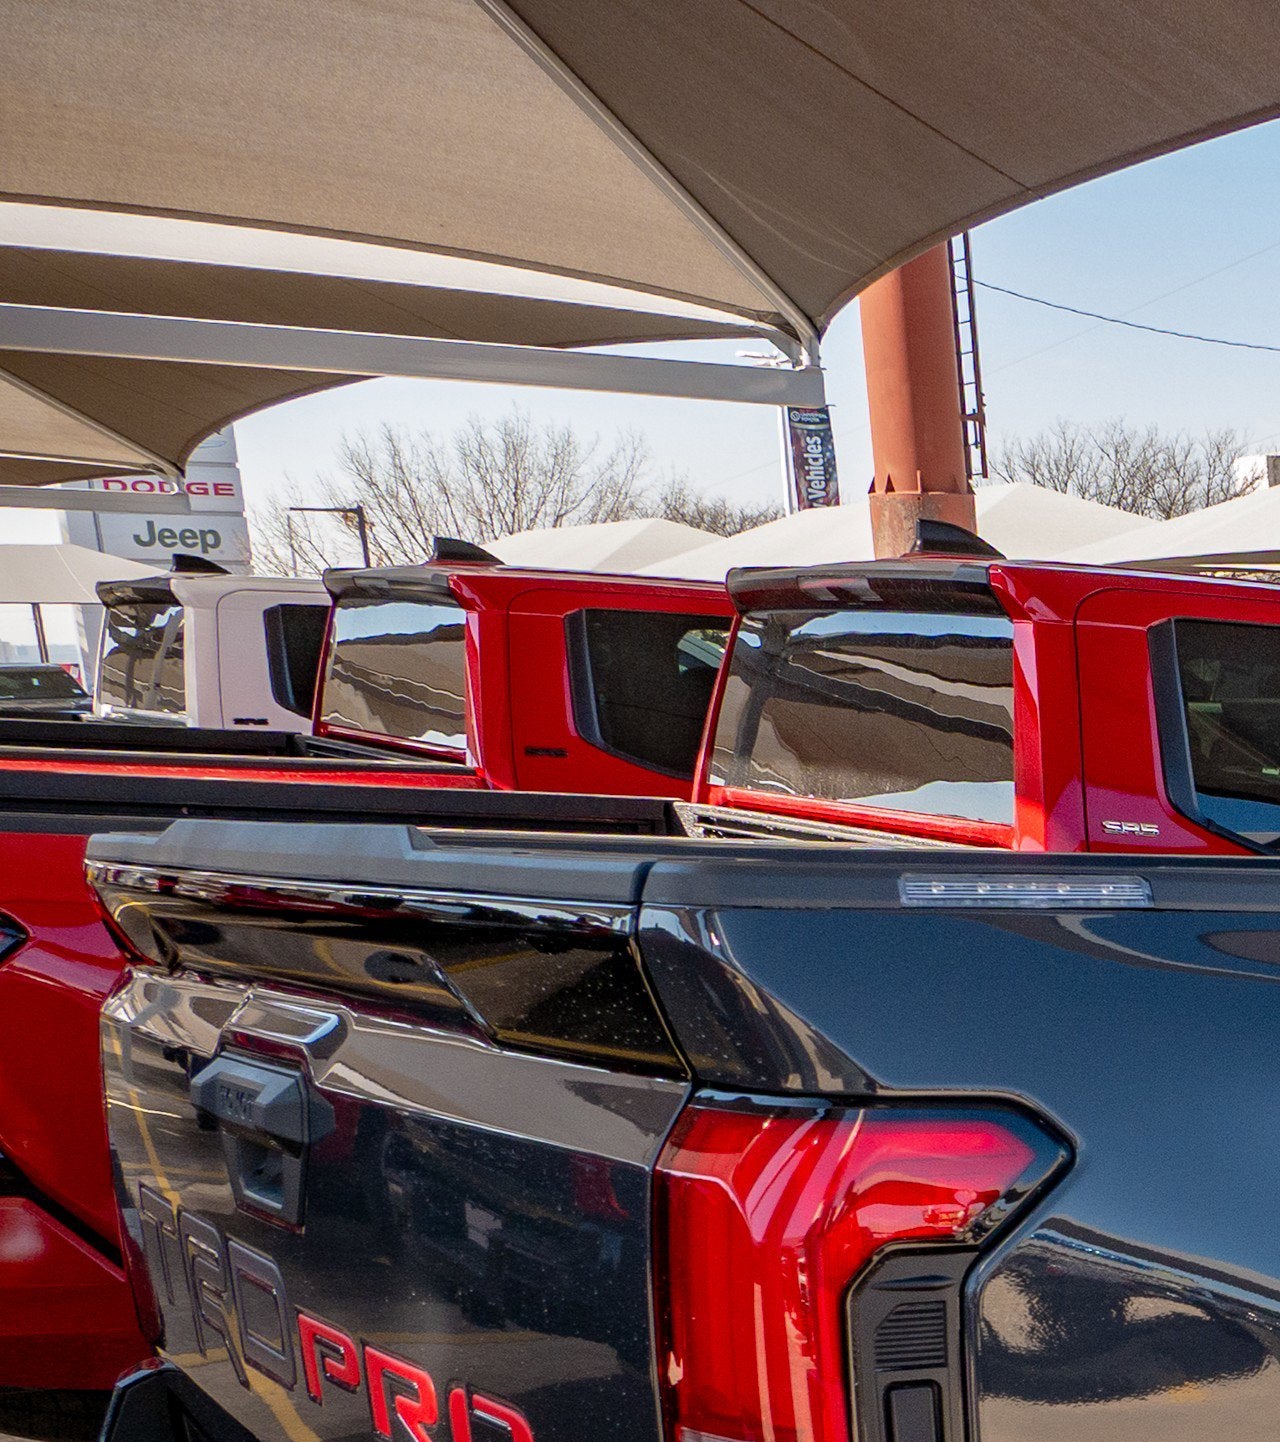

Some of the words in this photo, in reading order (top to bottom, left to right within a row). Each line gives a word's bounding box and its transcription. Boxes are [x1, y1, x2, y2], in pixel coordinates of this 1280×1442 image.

[803, 436, 827, 500] Vehicles
[133, 520, 221, 554] Jeep
[139, 1180, 298, 1393] TRD
